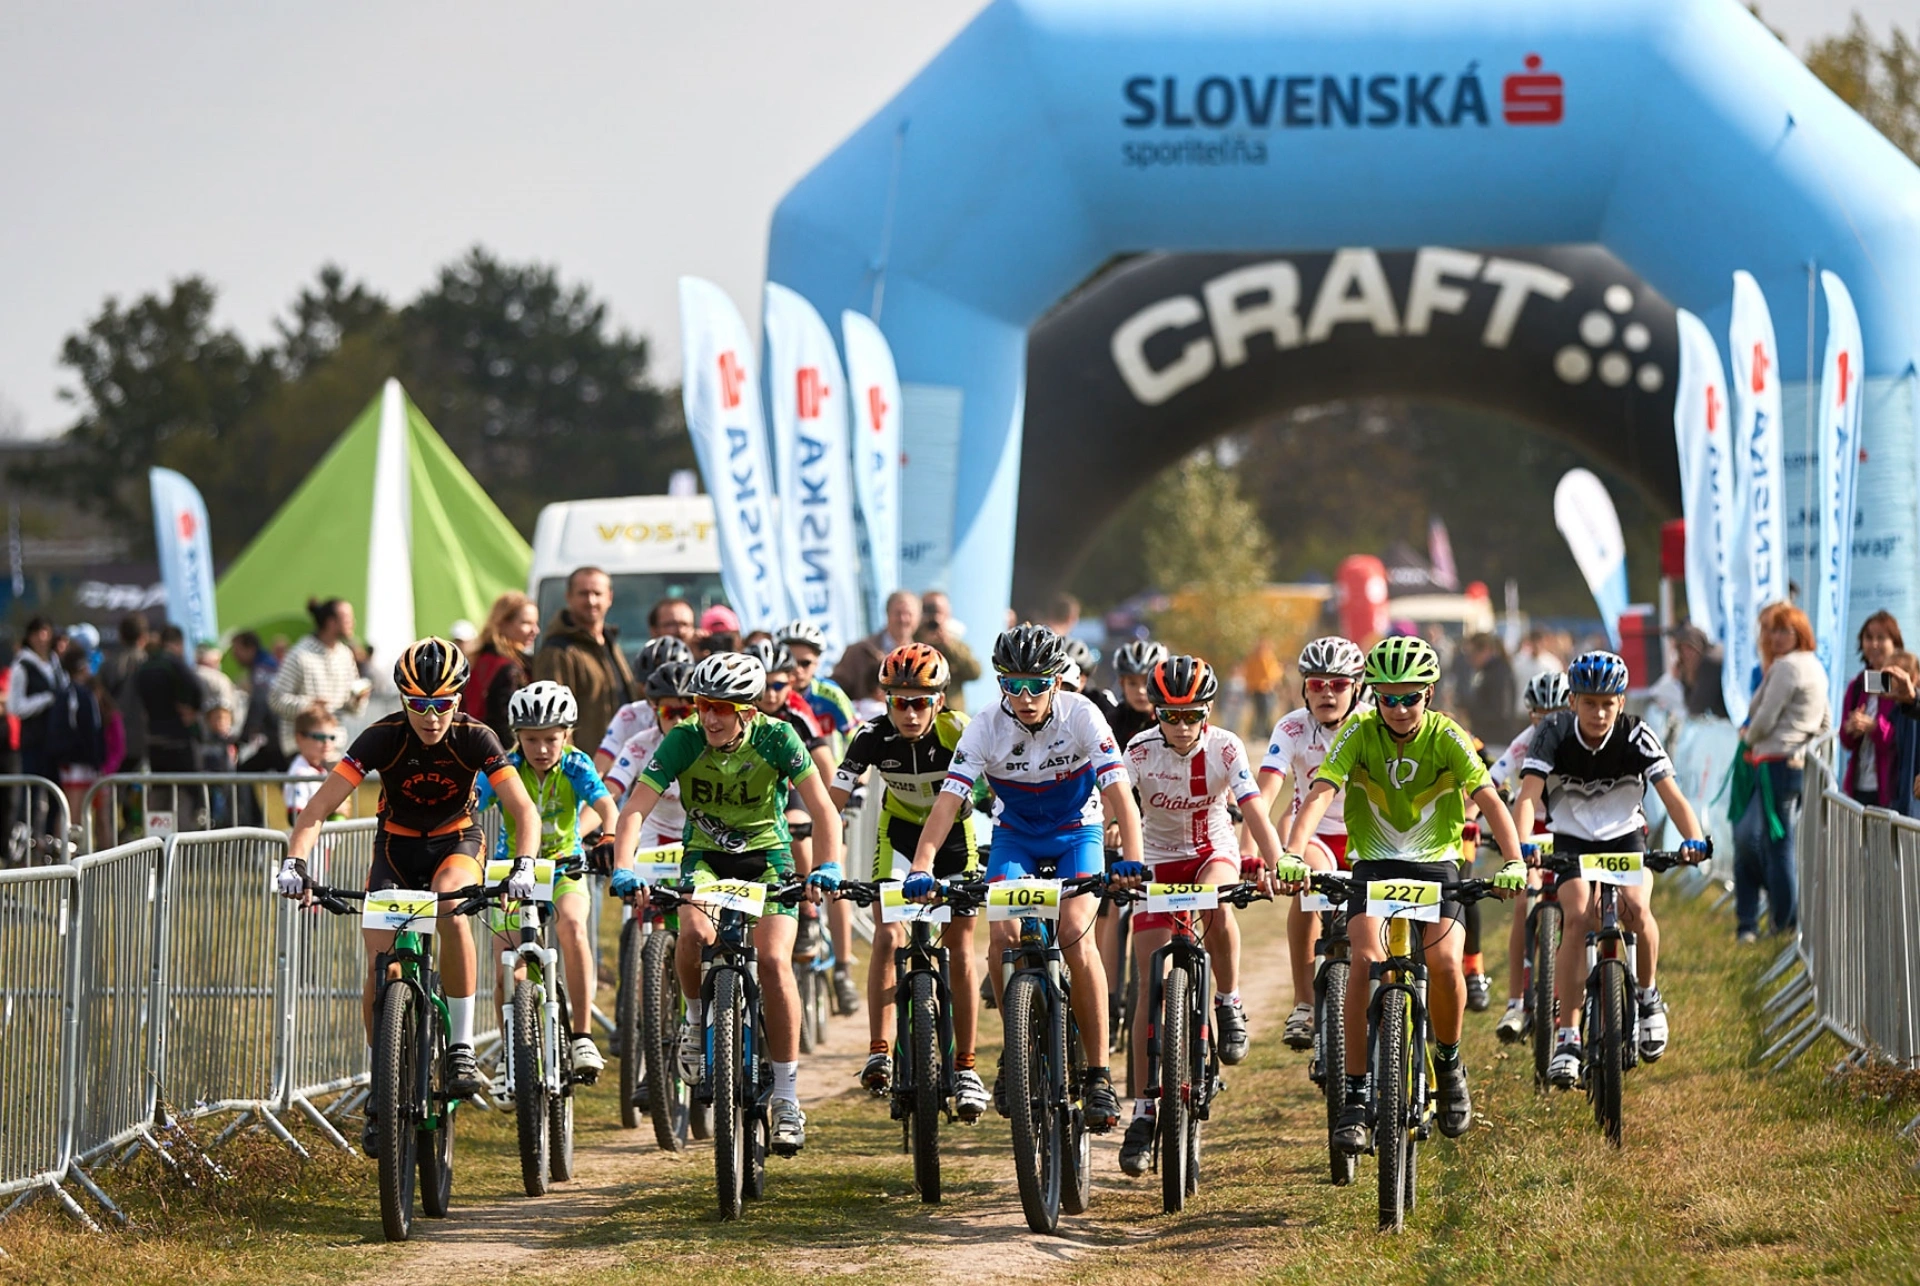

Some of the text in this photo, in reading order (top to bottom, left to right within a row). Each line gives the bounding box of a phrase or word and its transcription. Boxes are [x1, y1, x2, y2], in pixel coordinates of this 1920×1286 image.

[1122, 58, 1490, 128] SLOVENSKÁ
[1110, 246, 1573, 403] CRAFT
[1039, 753, 1080, 770] CASTA
[691, 778, 761, 805] BKL
[1149, 792, 1217, 811] Château
[655, 851, 677, 863] 91
[1595, 856, 1630, 872] 466
[710, 884, 750, 898] 323
[1005, 889, 1045, 906] 105
[1384, 885, 1425, 903] 227
